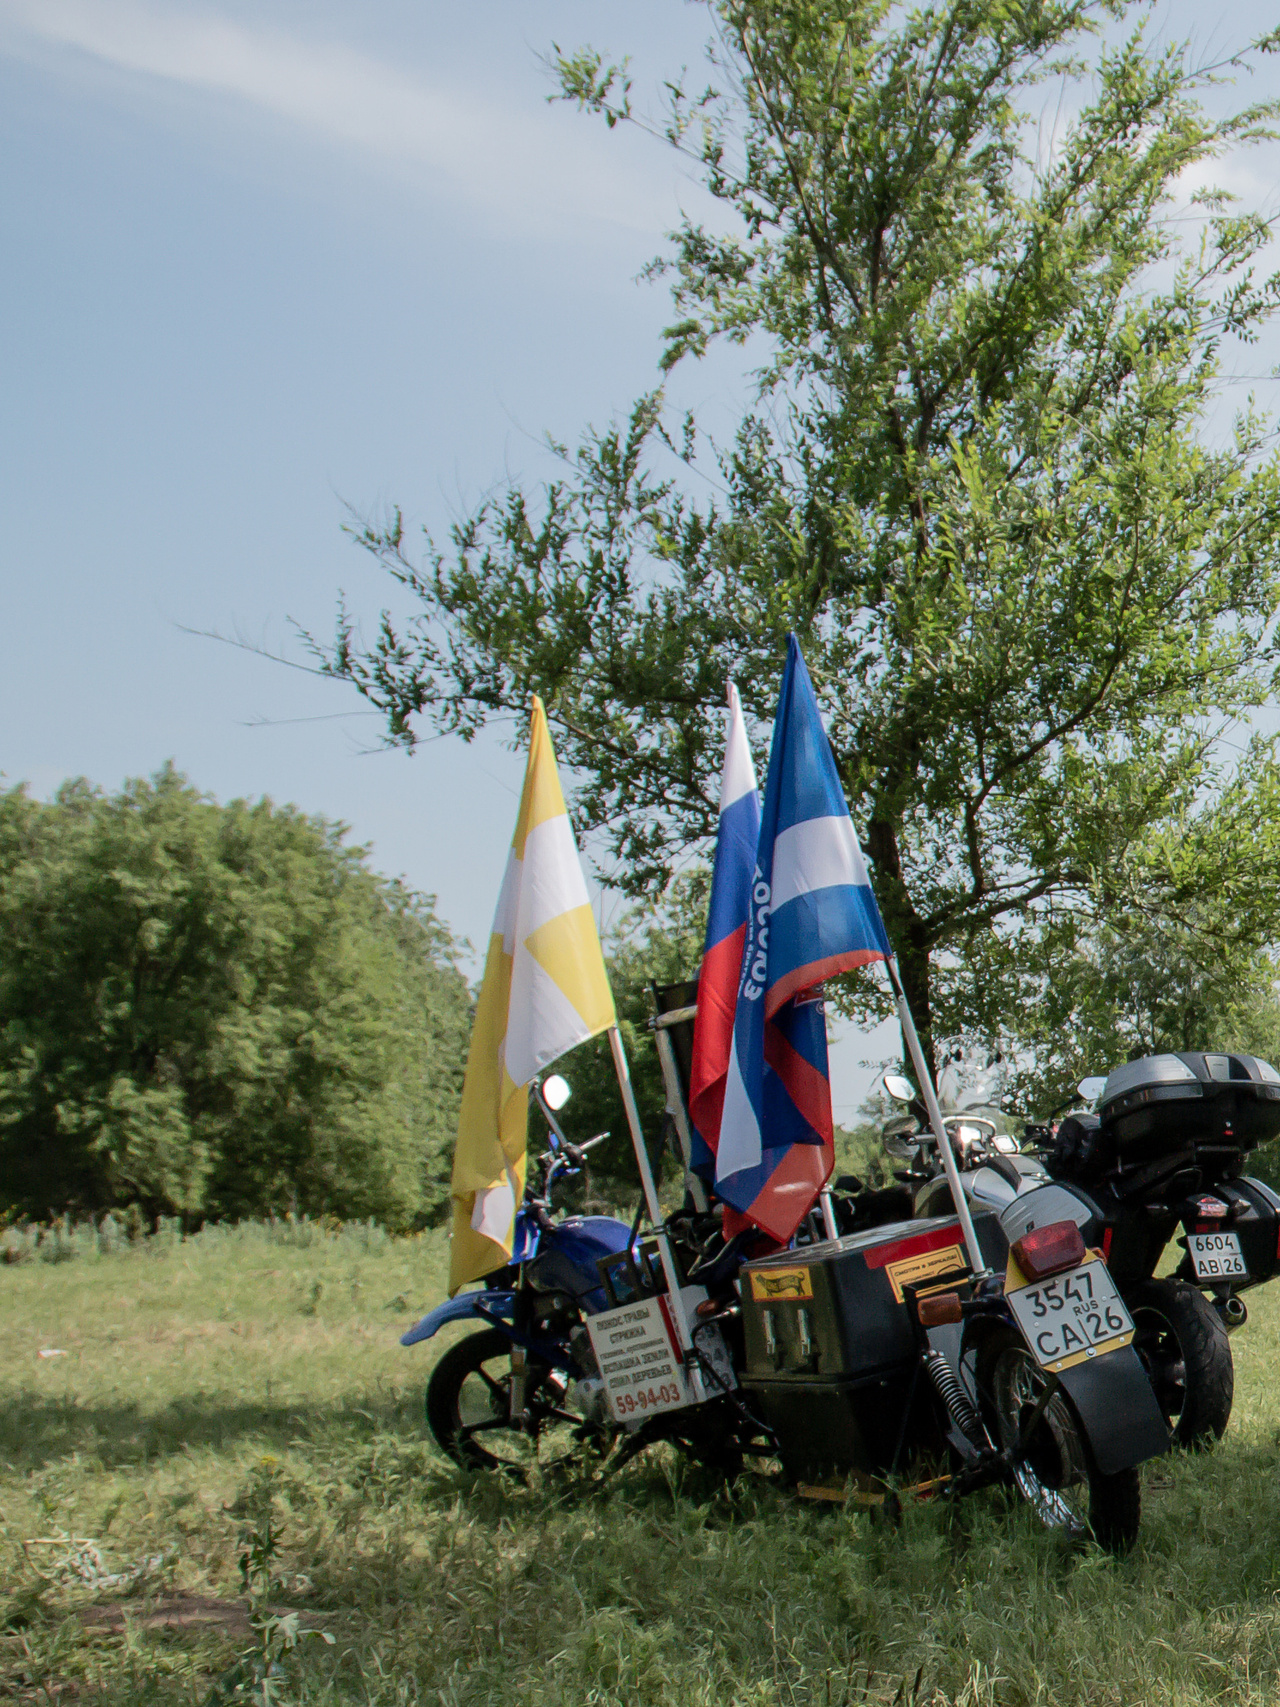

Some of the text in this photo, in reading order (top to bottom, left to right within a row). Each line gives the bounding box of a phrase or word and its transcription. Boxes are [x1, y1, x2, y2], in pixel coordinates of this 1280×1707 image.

[1196, 1236, 1234, 1251] 6604
[1223, 1258, 1243, 1272] 26
[1025, 1272, 1093, 1317] 3547
[623, 1307, 650, 1323] ТРАВЫ
[1073, 1300, 1099, 1316] RUS
[1036, 1306, 1123, 1356] СА 26
[631, 1364, 673, 1384] ДЕРЕВЬЕВ
[616, 1383, 680, 1414] 59-94-03
